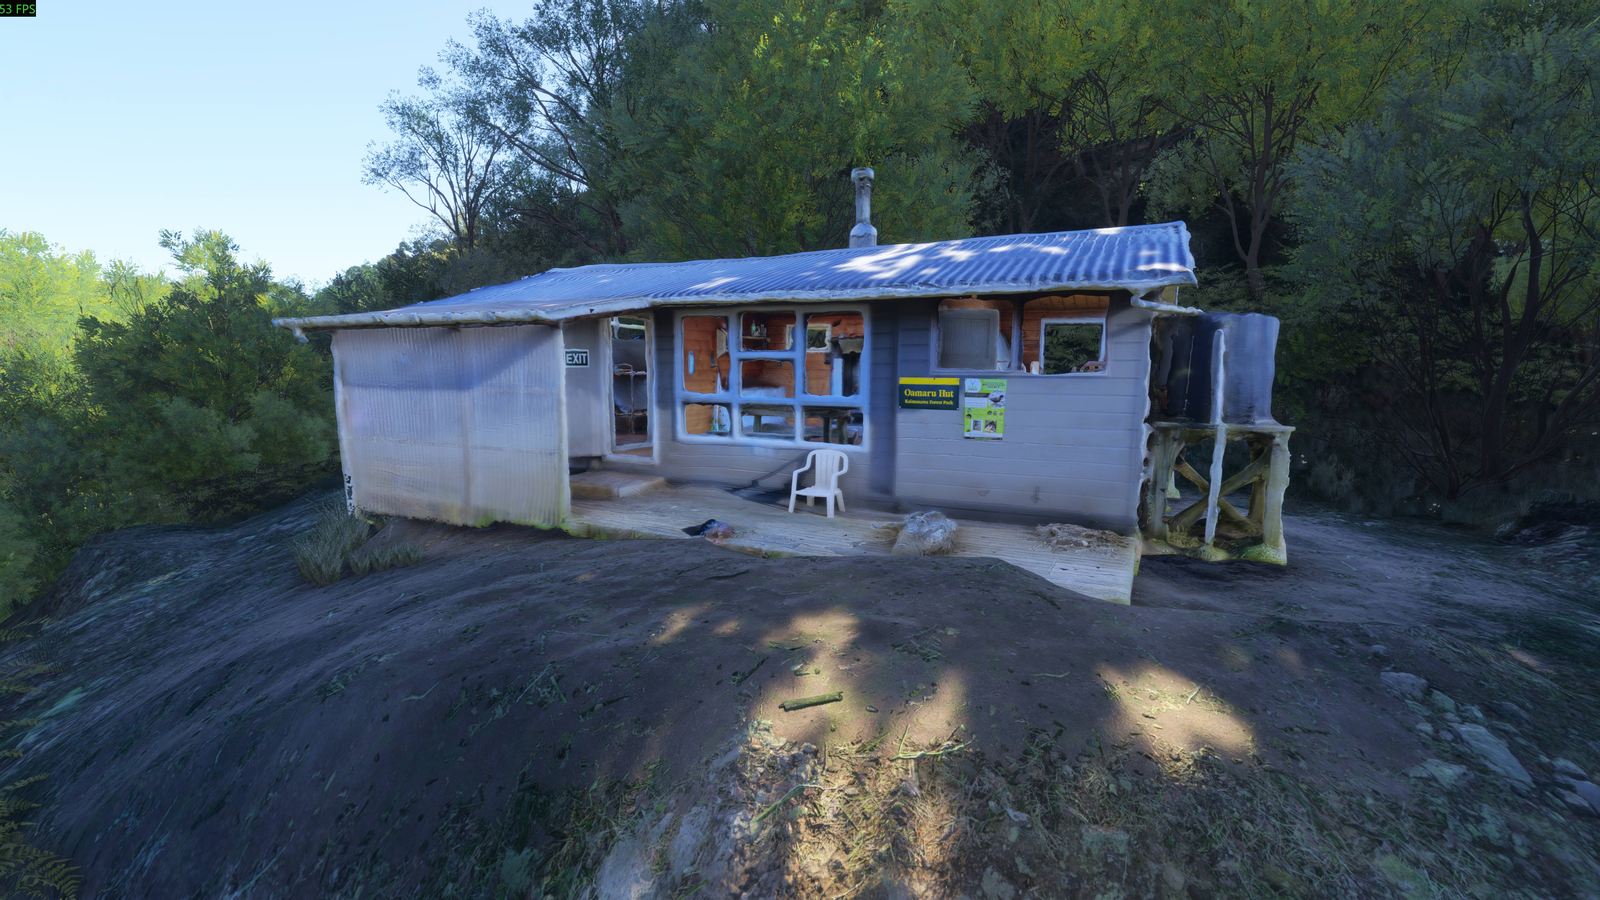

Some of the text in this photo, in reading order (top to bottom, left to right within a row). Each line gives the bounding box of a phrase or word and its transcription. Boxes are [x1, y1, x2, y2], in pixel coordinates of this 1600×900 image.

[566, 353, 587, 364] EXIT
[904, 389, 954, 398] Oamaru Hut
